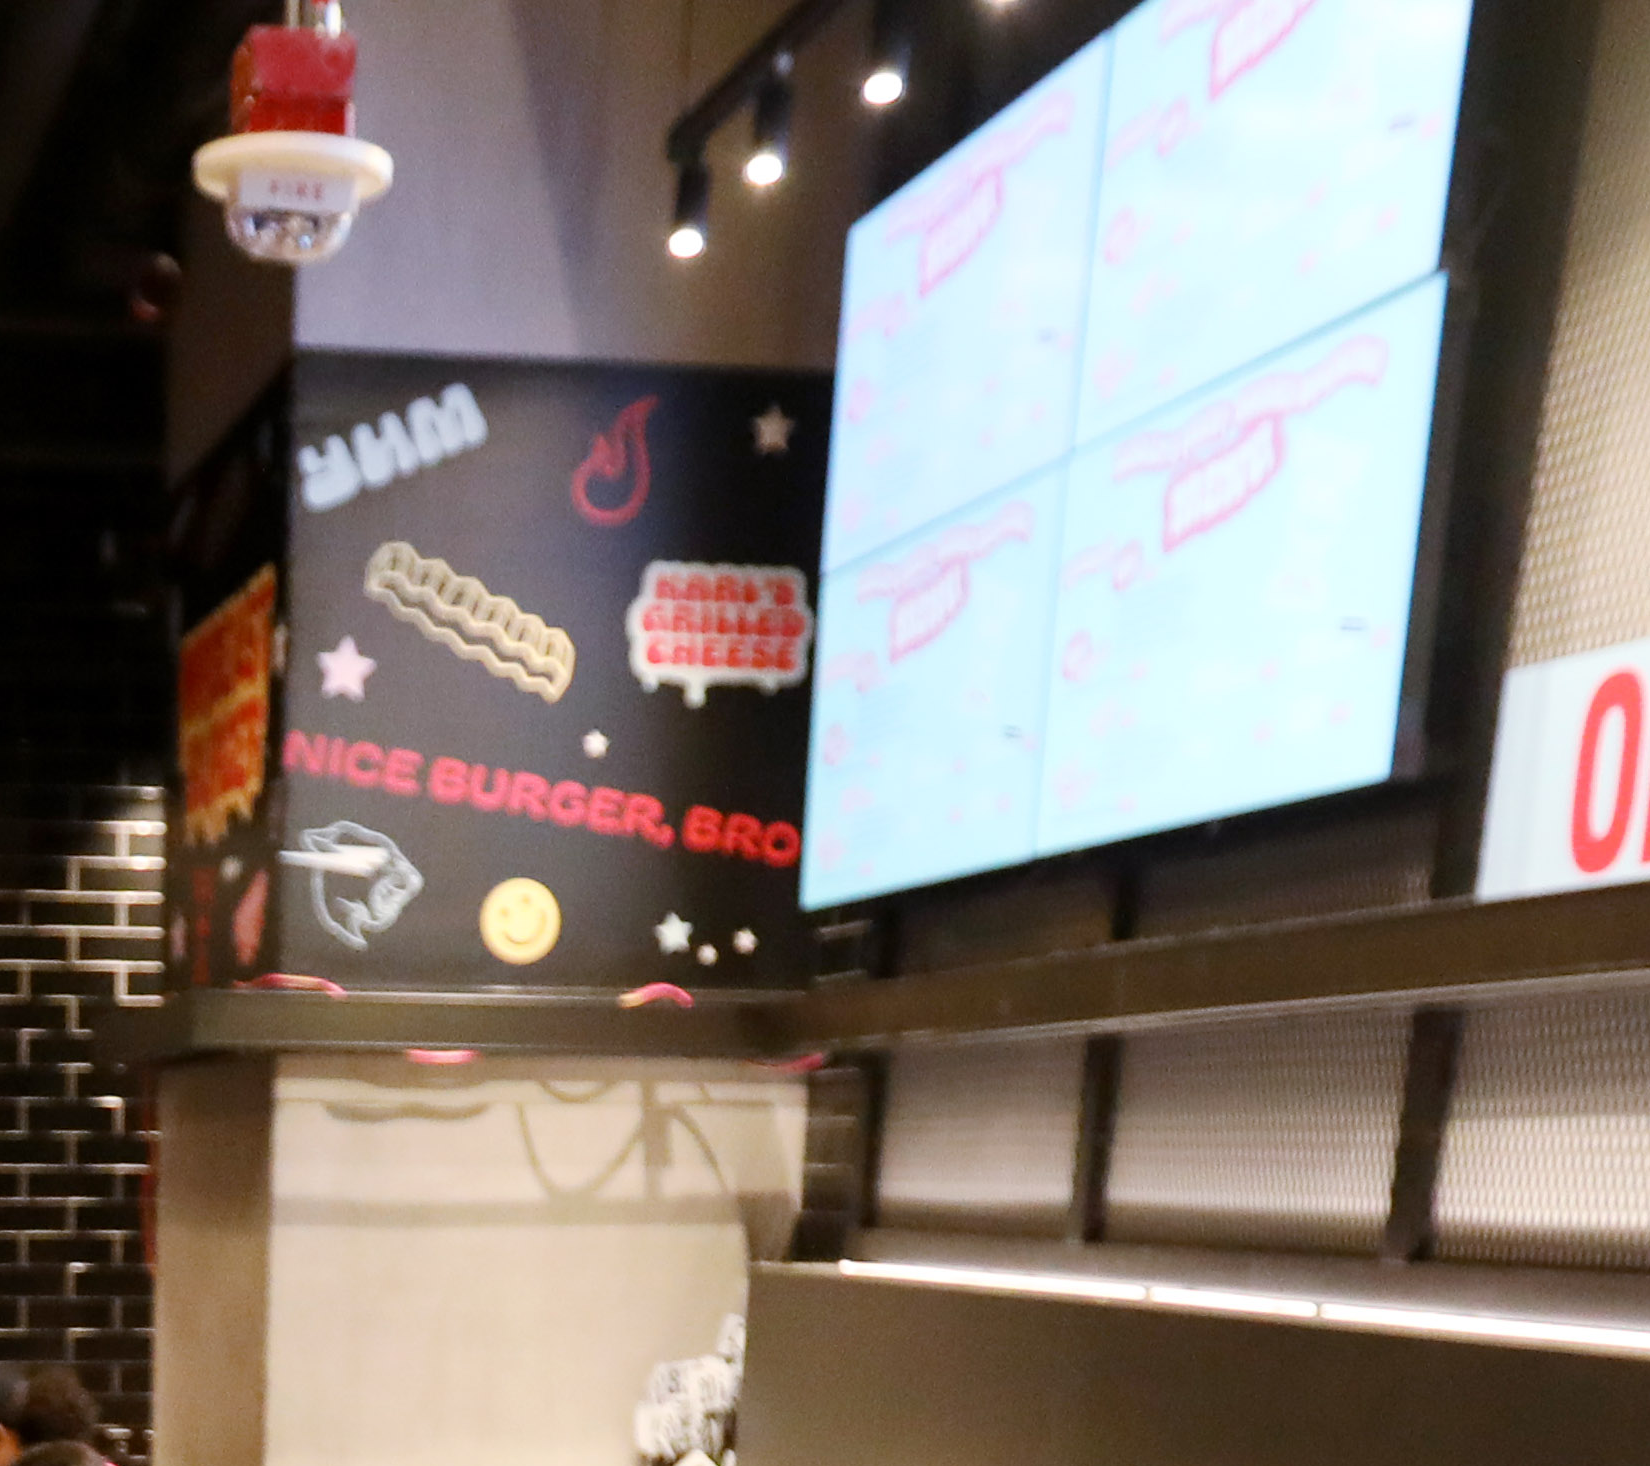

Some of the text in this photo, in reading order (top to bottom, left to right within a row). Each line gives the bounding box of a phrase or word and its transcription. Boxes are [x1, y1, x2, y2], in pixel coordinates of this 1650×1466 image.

[646, 637, 796, 671] CHEESE
[281, 729, 801, 869] NICE BURGER, BRO
